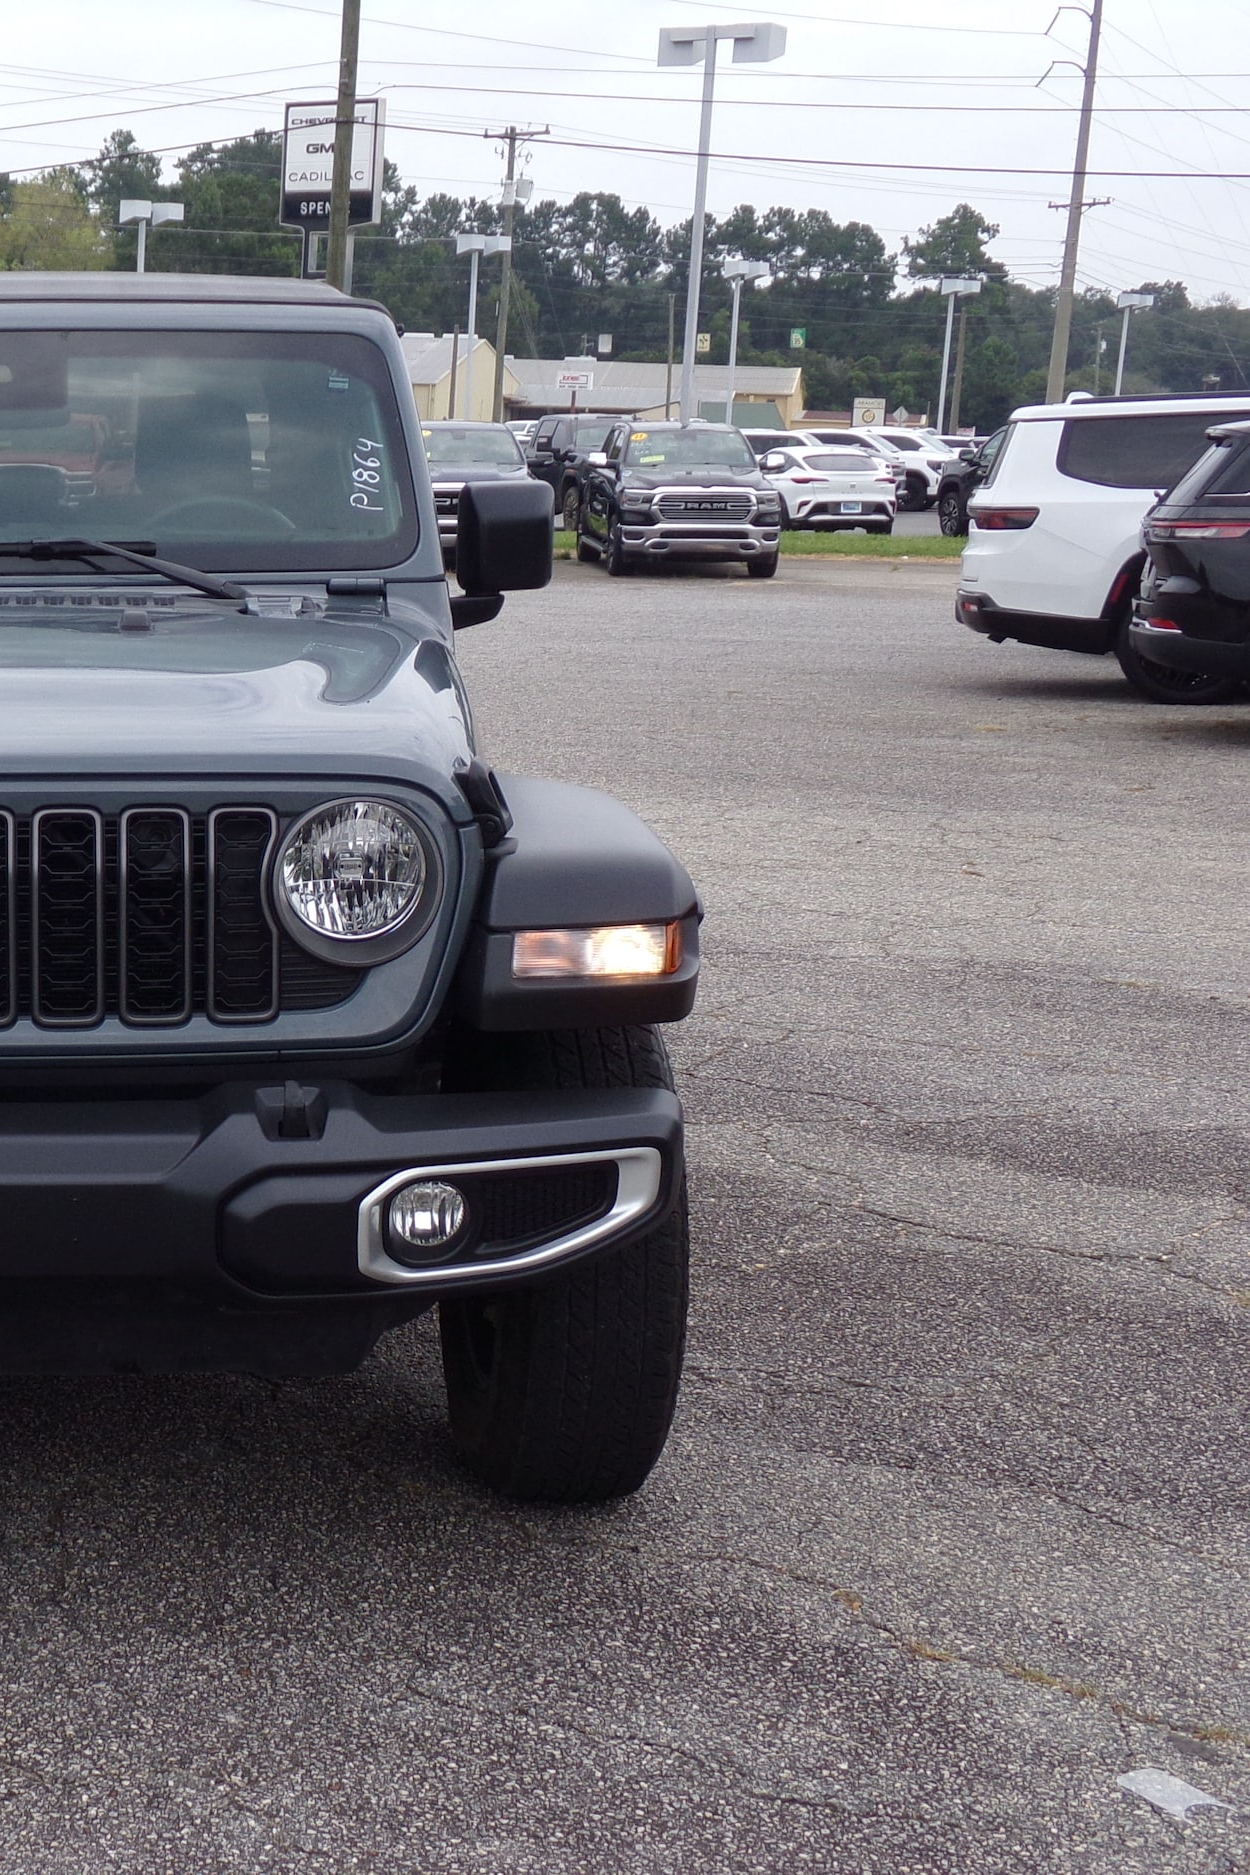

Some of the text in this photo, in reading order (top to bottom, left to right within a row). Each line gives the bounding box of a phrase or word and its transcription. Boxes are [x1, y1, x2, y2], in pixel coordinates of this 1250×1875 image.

[306, 144, 336, 154] GM
[288, 171, 365, 182] CADILC
[300, 201, 350, 215] SPEN
[350, 438, 384, 511] P1864
[686, 502, 726, 510] RAM
